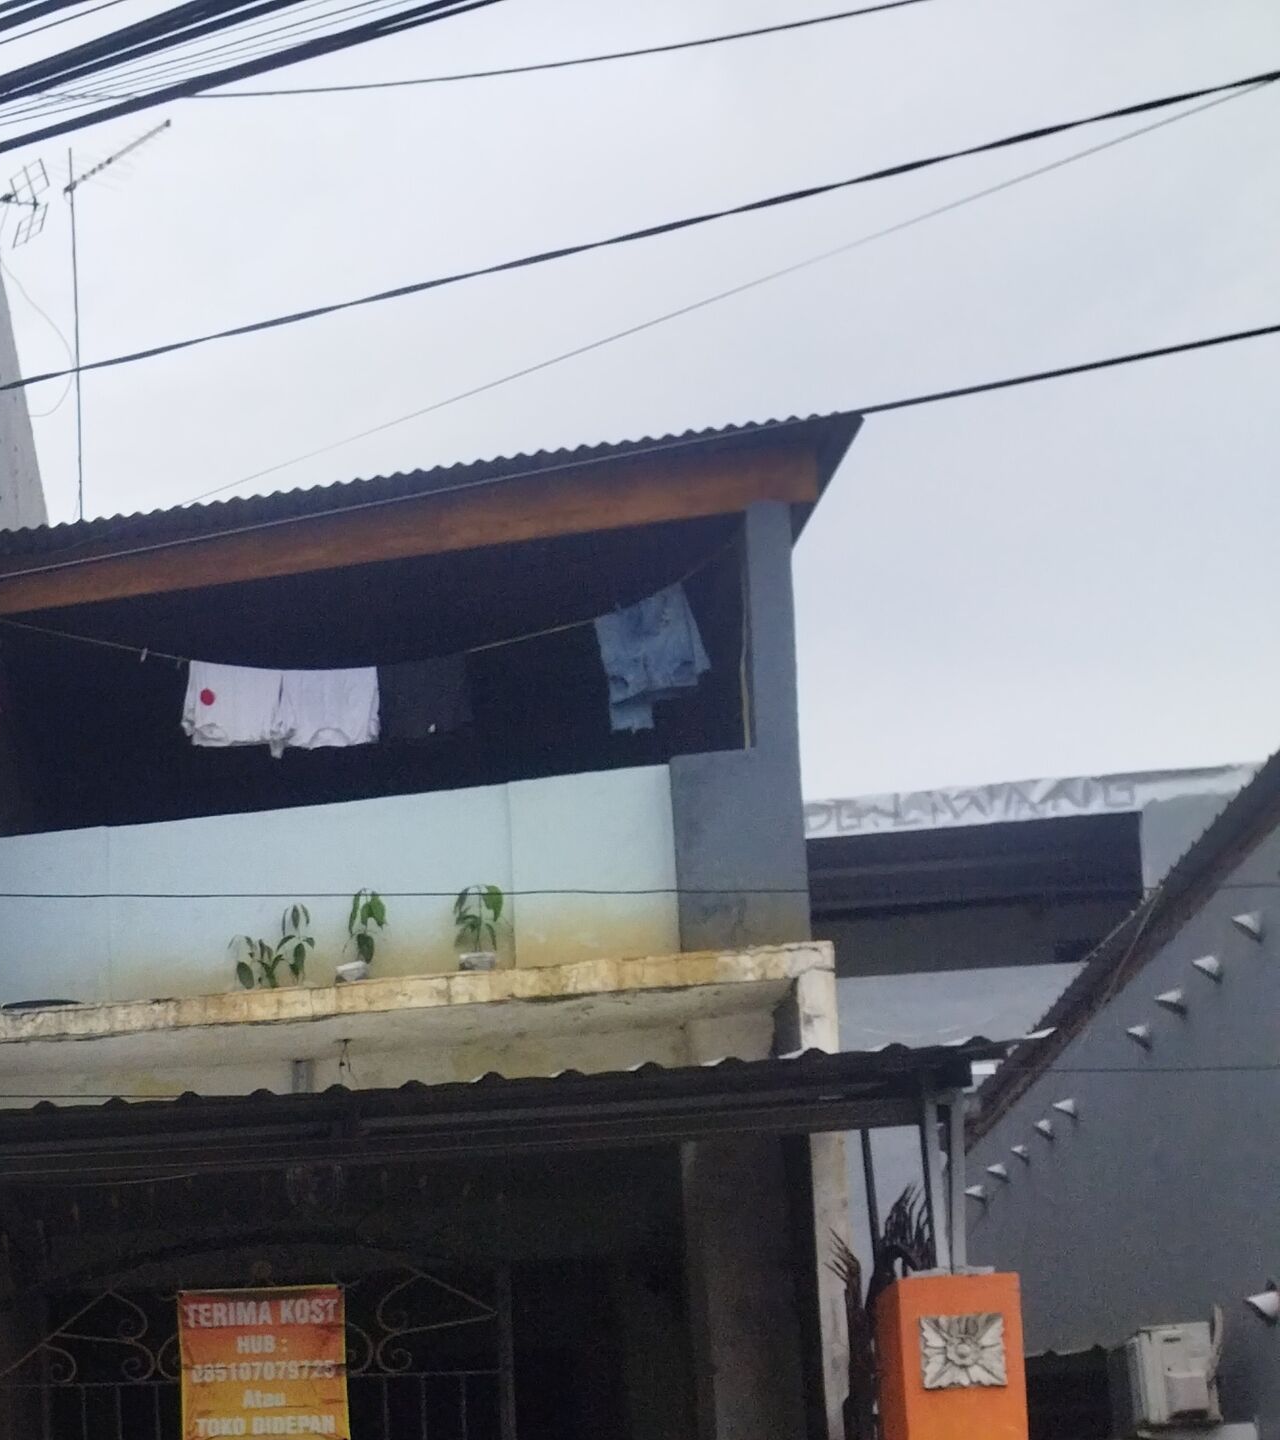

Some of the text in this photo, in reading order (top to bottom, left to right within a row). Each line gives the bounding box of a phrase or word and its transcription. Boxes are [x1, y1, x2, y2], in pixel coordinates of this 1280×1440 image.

[184, 1299, 338, 1328] TERIMA KOST
[236, 1335, 276, 1354] HUB
[196, 1417, 245, 1437] TOKO
